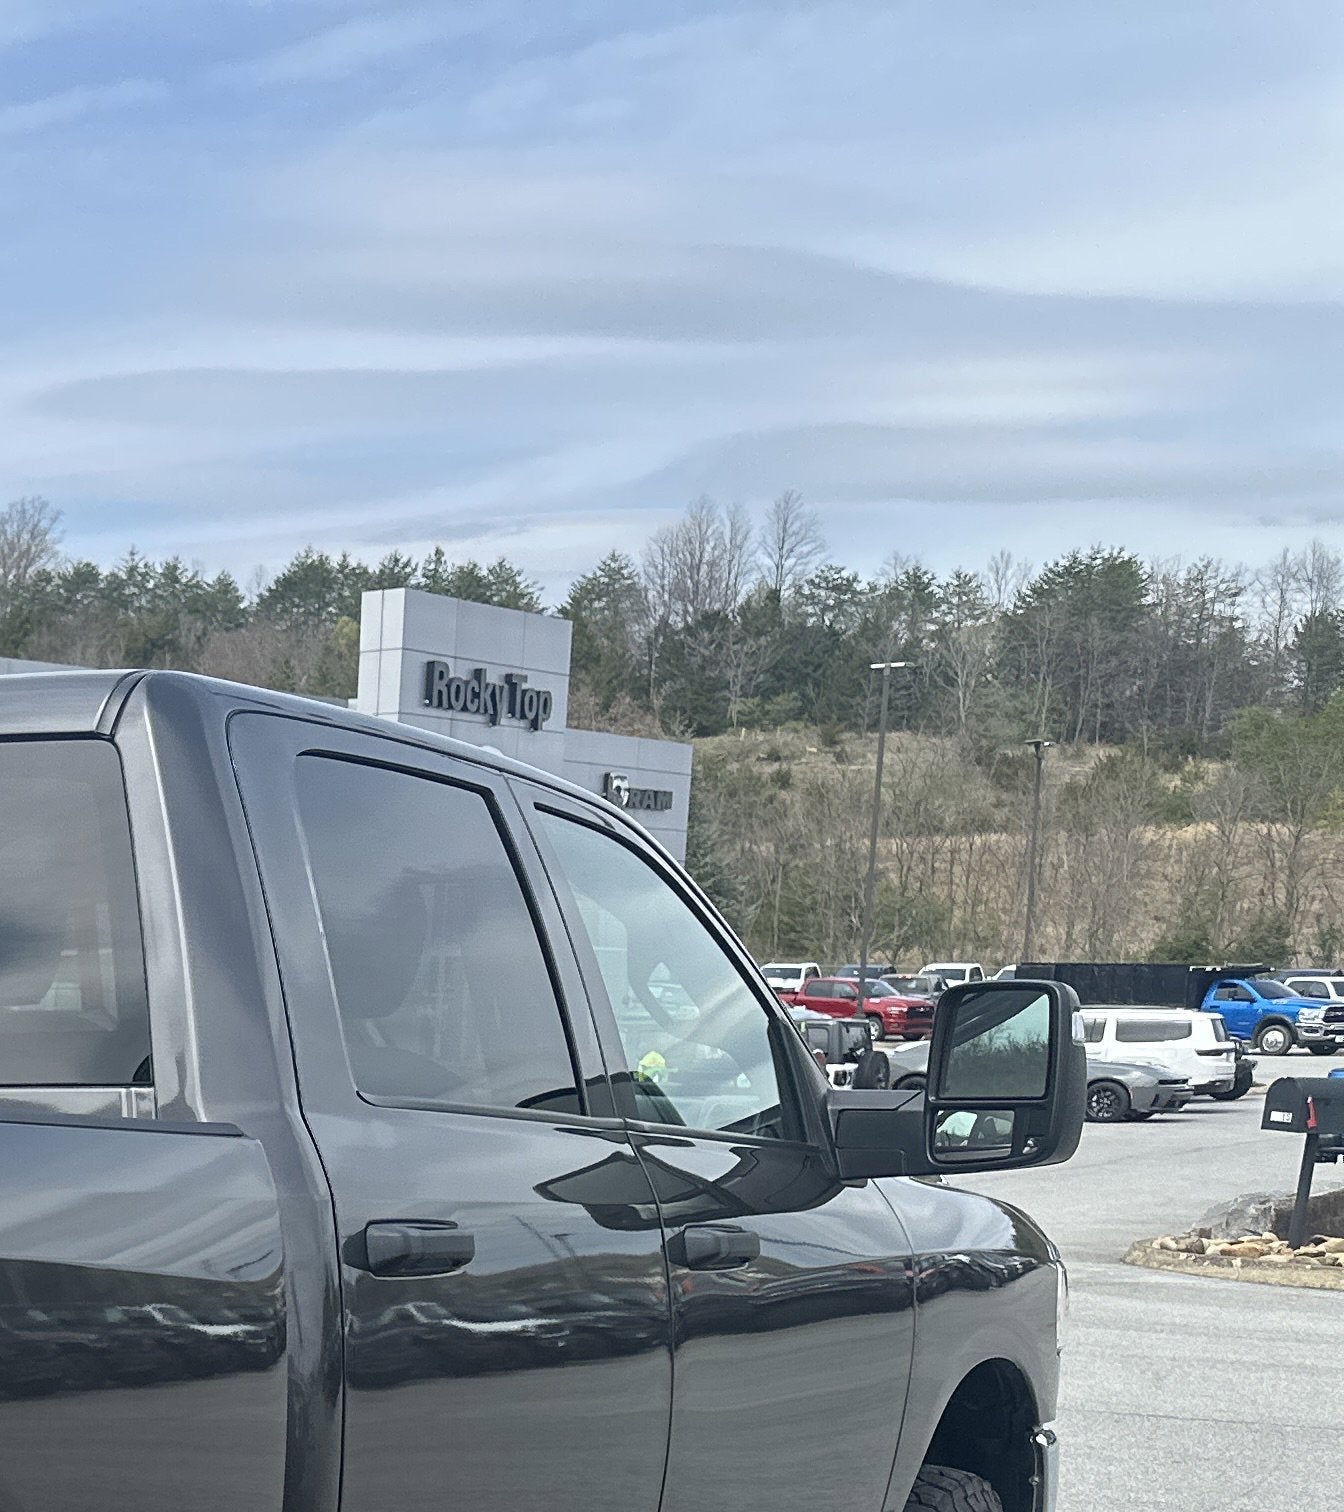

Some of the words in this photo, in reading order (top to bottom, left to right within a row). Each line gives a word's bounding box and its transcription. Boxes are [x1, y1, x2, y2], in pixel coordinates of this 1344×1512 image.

[425, 661, 509, 726] Rocky
[505, 673, 552, 731] Top
[628, 788, 673, 811] RAM
